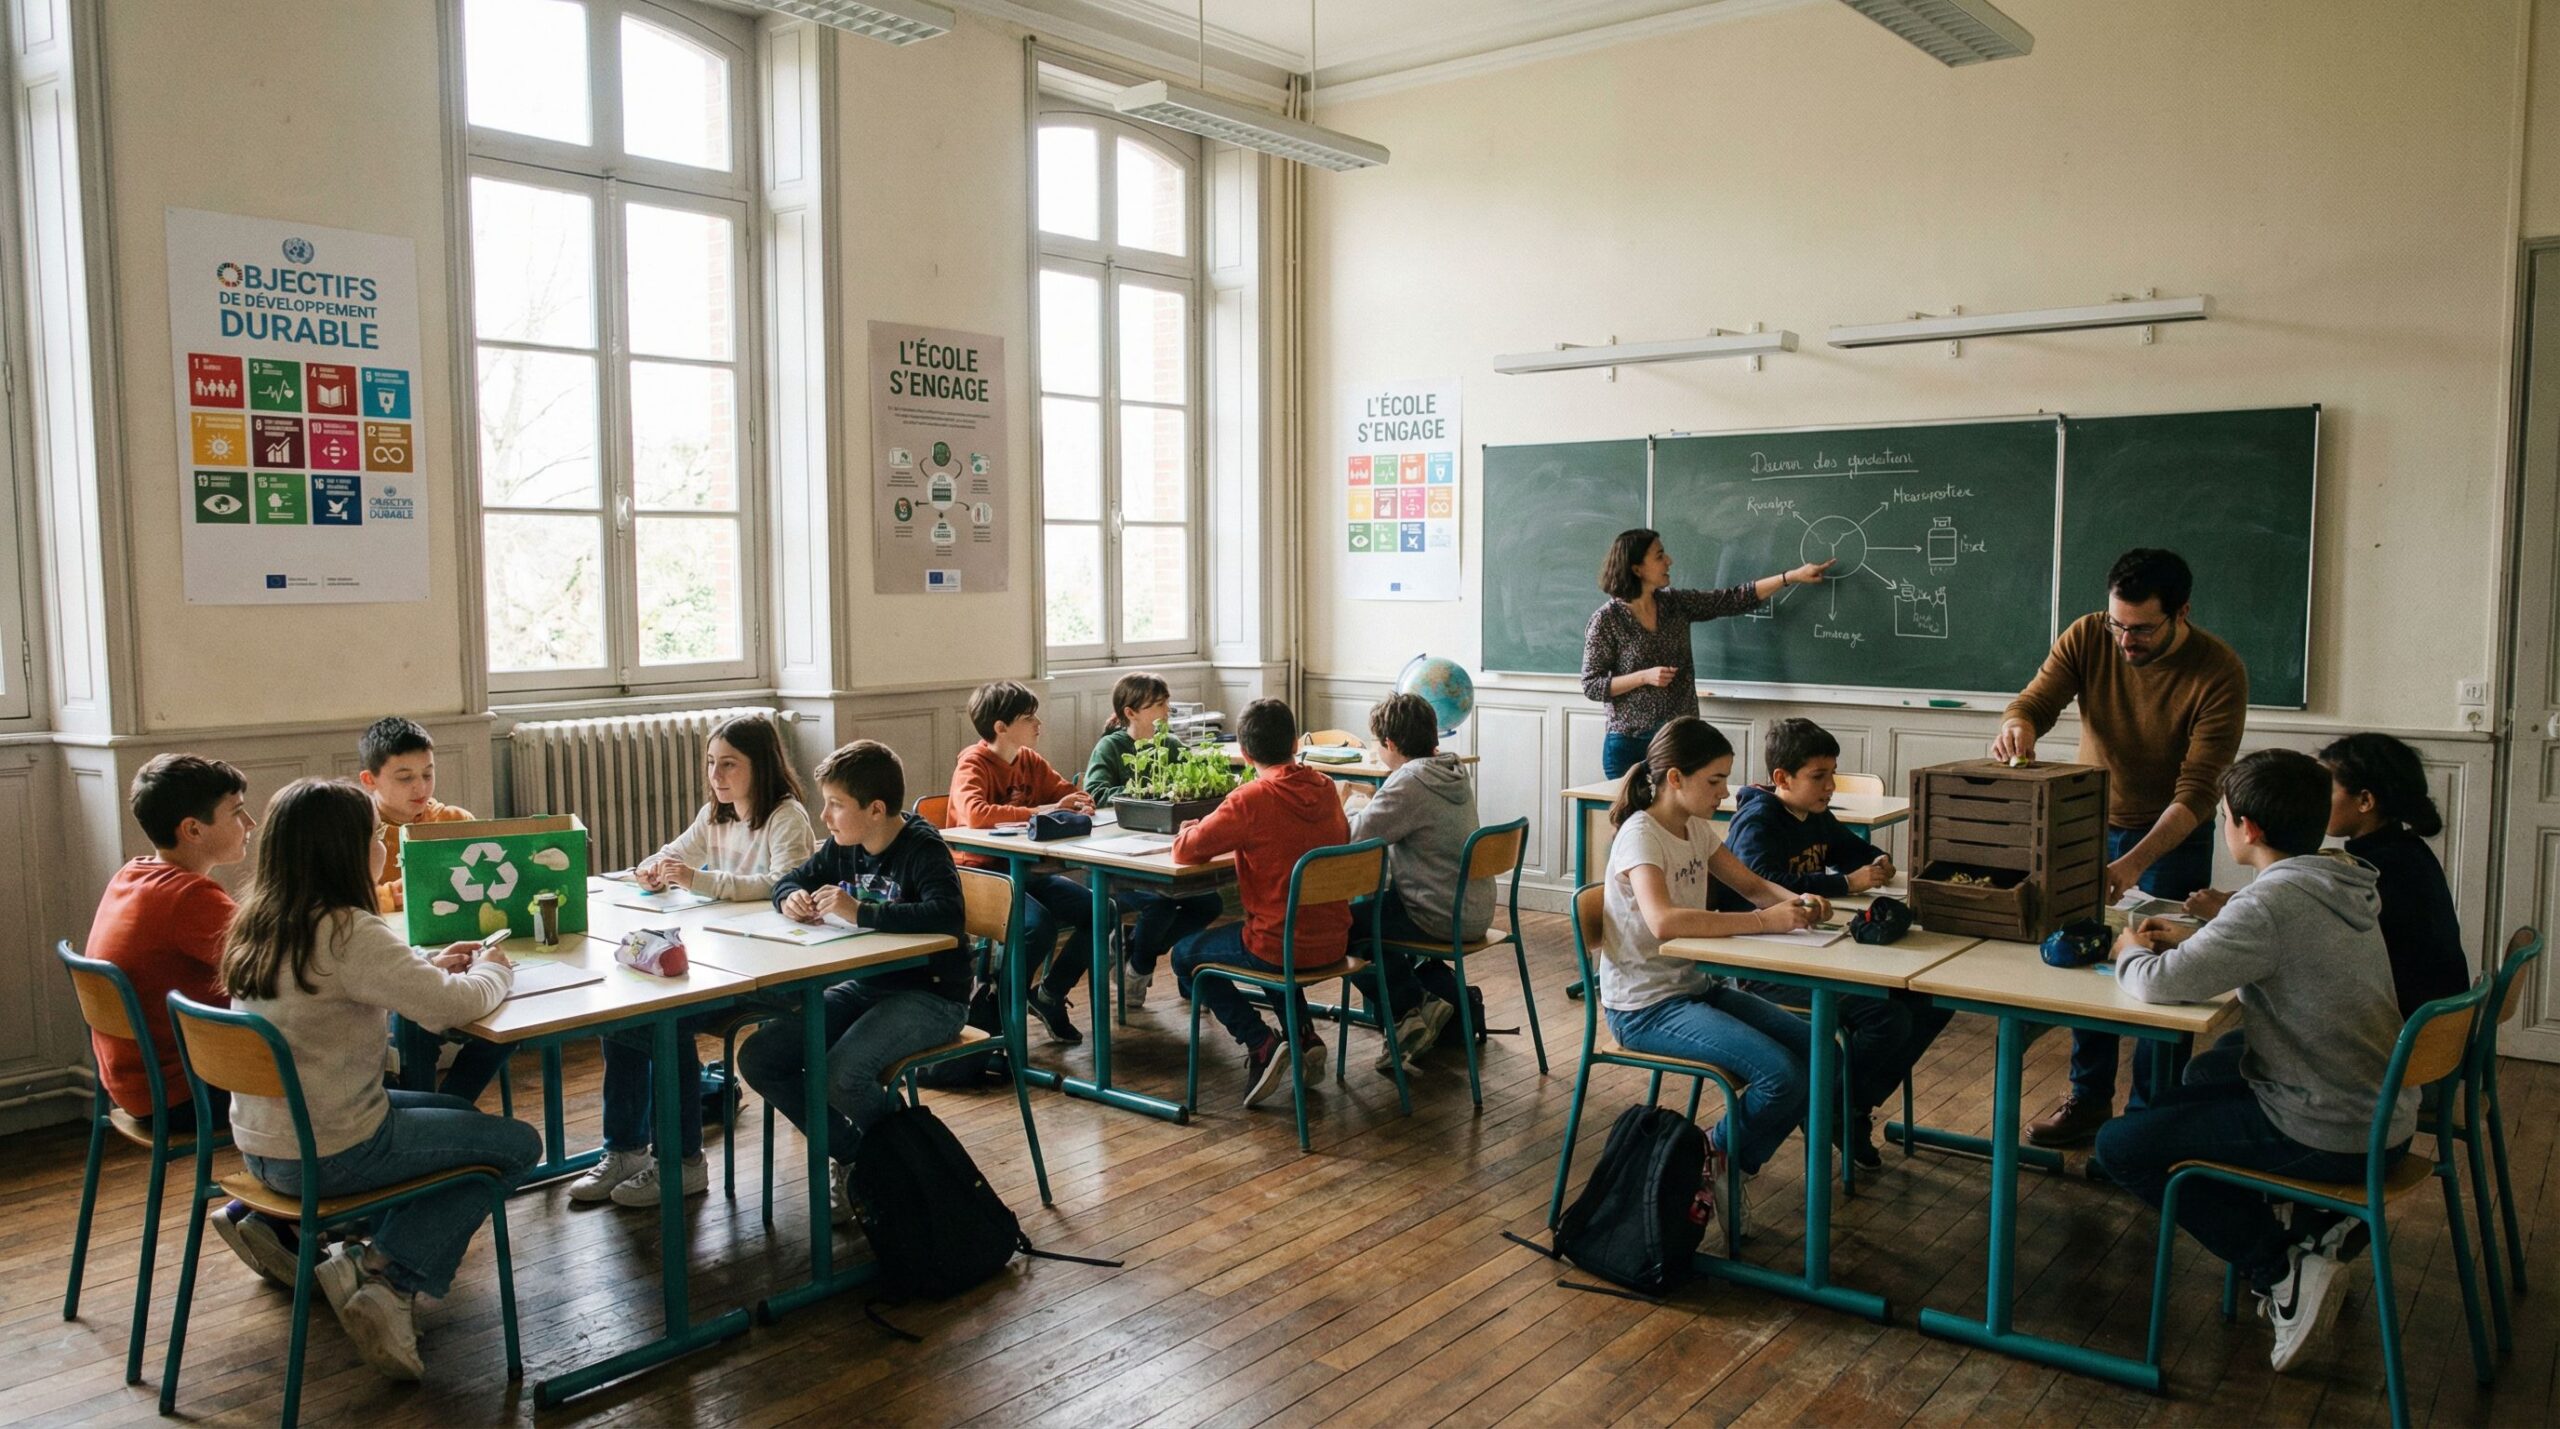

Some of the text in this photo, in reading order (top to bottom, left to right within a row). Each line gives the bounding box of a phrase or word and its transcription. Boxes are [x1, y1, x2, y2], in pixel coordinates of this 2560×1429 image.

[217, 262, 377, 301] OBJECTIFS
[219, 291, 377, 319] DE DÉVELOPPEMENT
[220, 309, 379, 350] DURABLE
[899, 338, 979, 373] L'ÉCOLE
[889, 370, 989, 402] S'ENGAGE
[1367, 393, 1437, 418] L'ÉCOLE
[1358, 419, 1445, 443] S'ENGAGE
